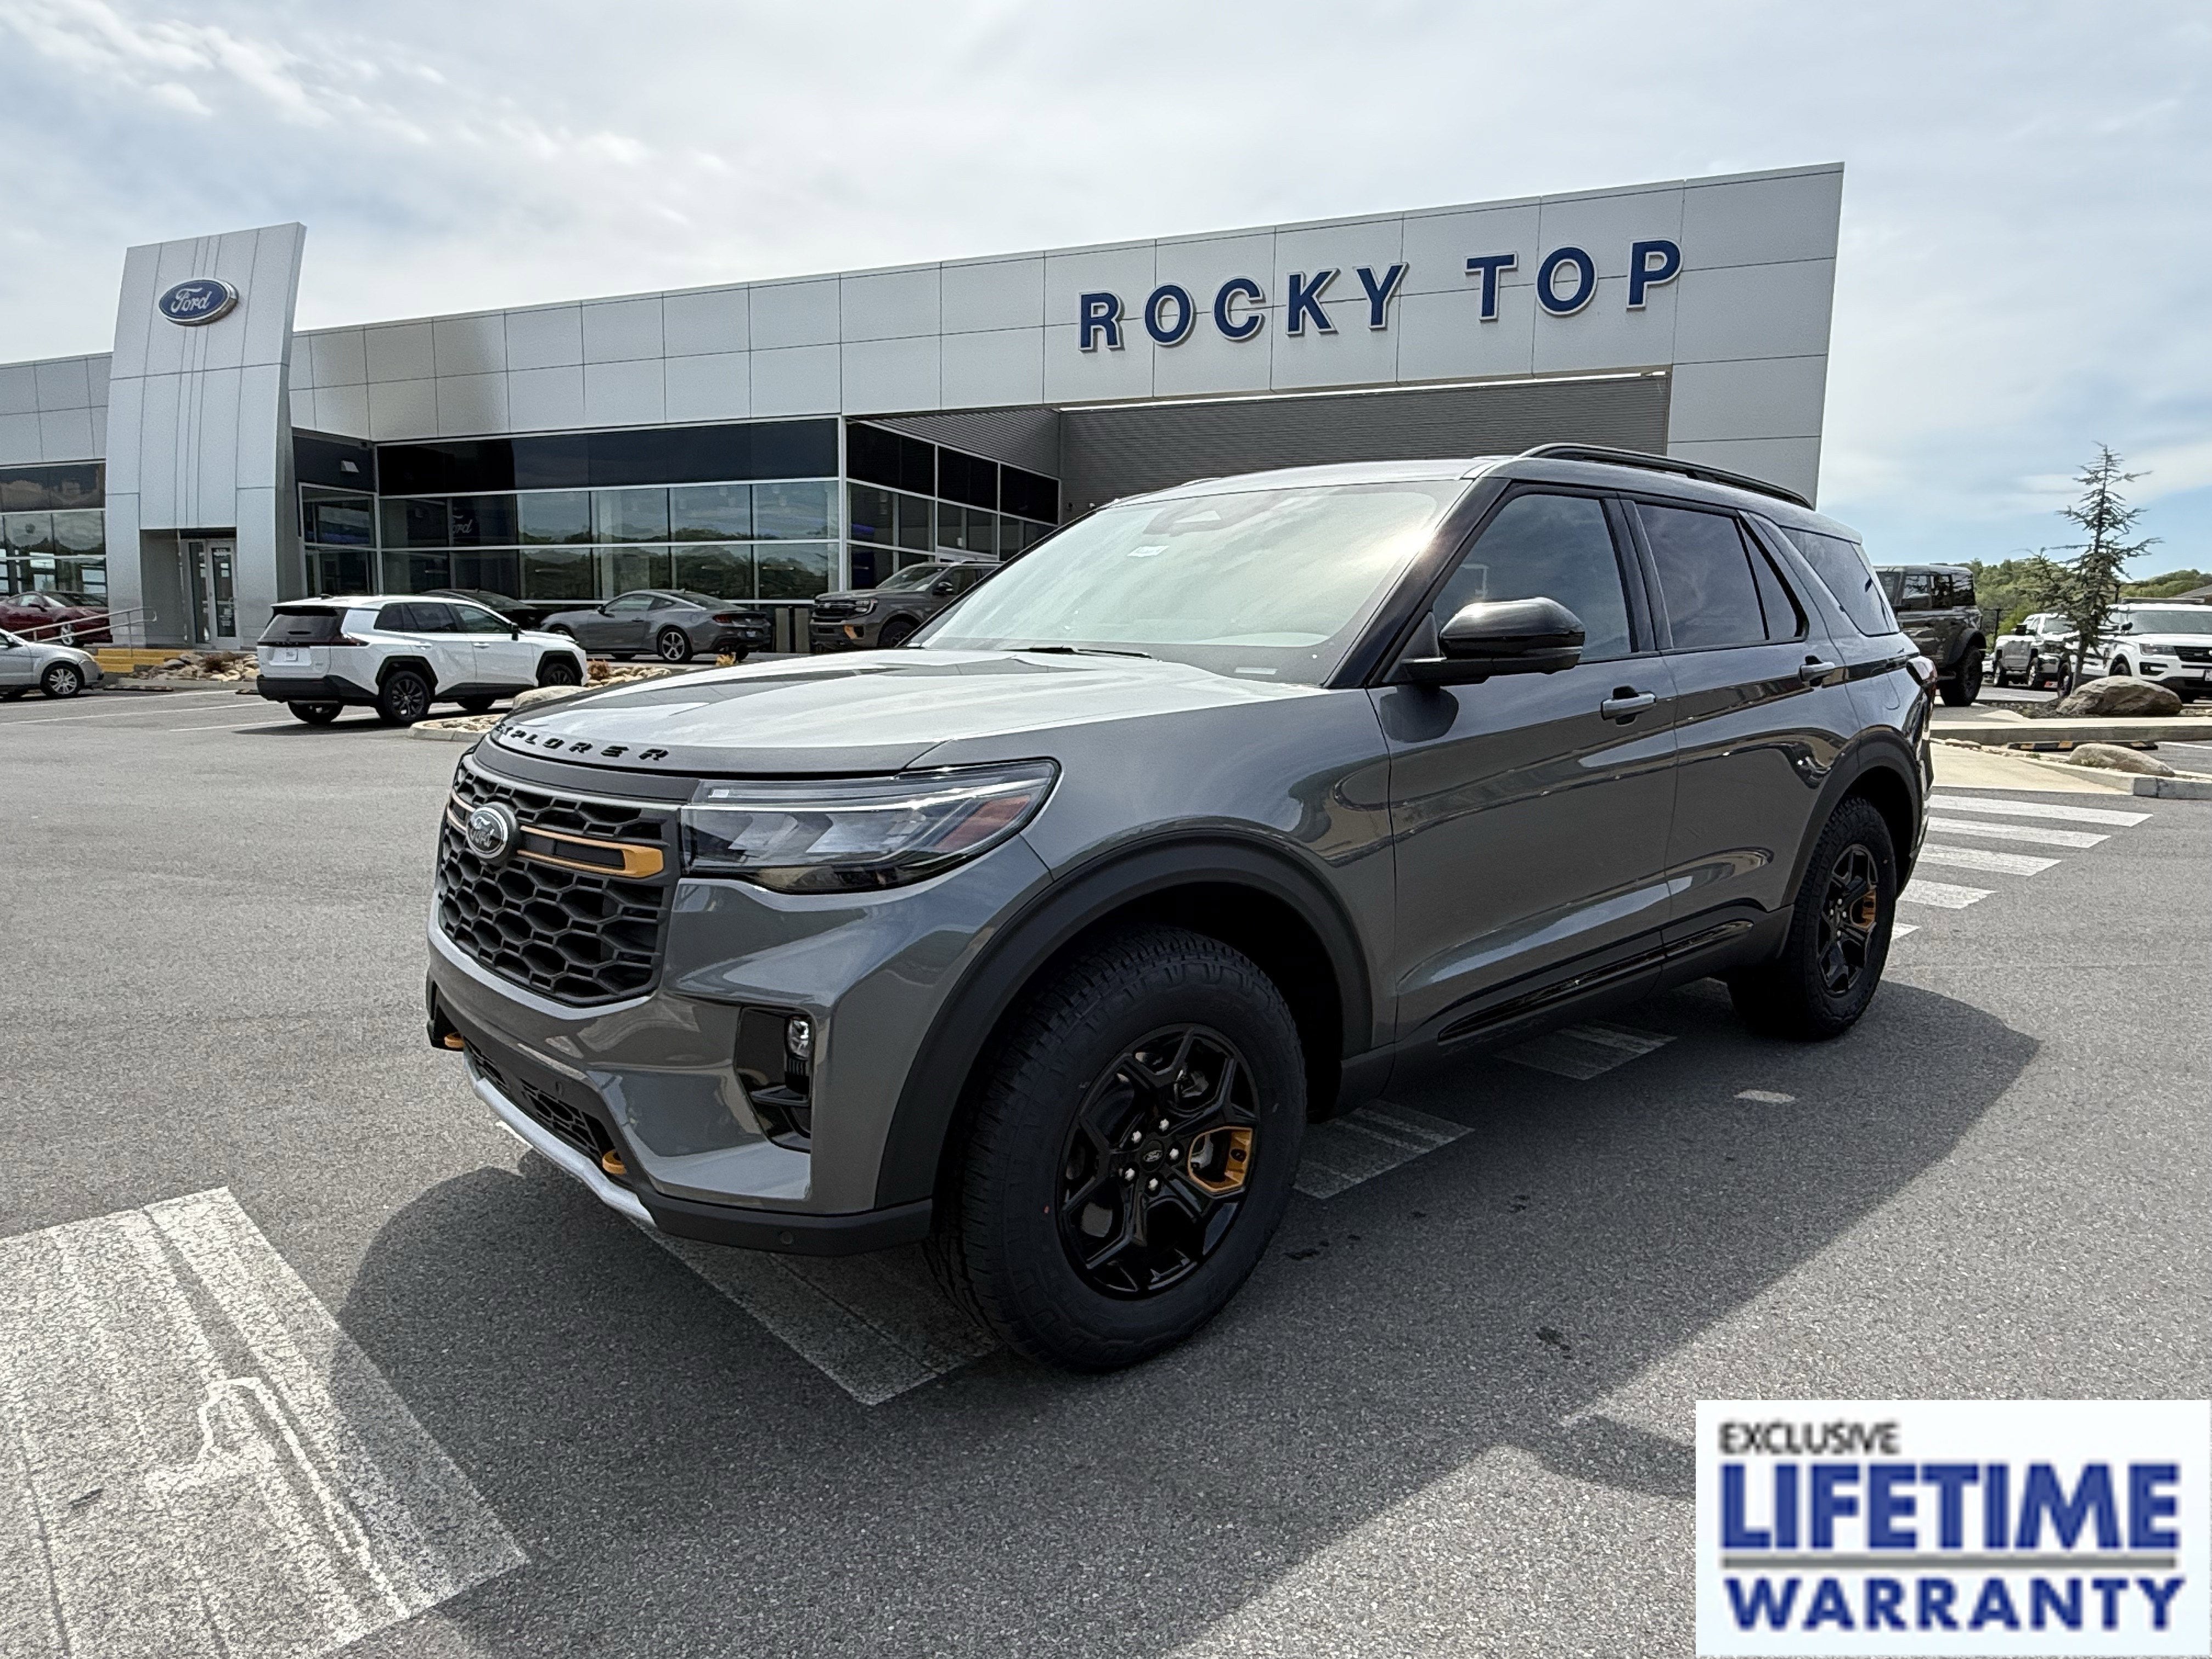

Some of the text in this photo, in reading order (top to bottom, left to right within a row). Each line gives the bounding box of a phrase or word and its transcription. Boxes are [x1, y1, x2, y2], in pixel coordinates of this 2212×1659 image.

[170, 287, 213, 313] Ford
[1079, 239, 1683, 352] ROCKY TOP
[494, 723, 669, 761] EXPLORER
